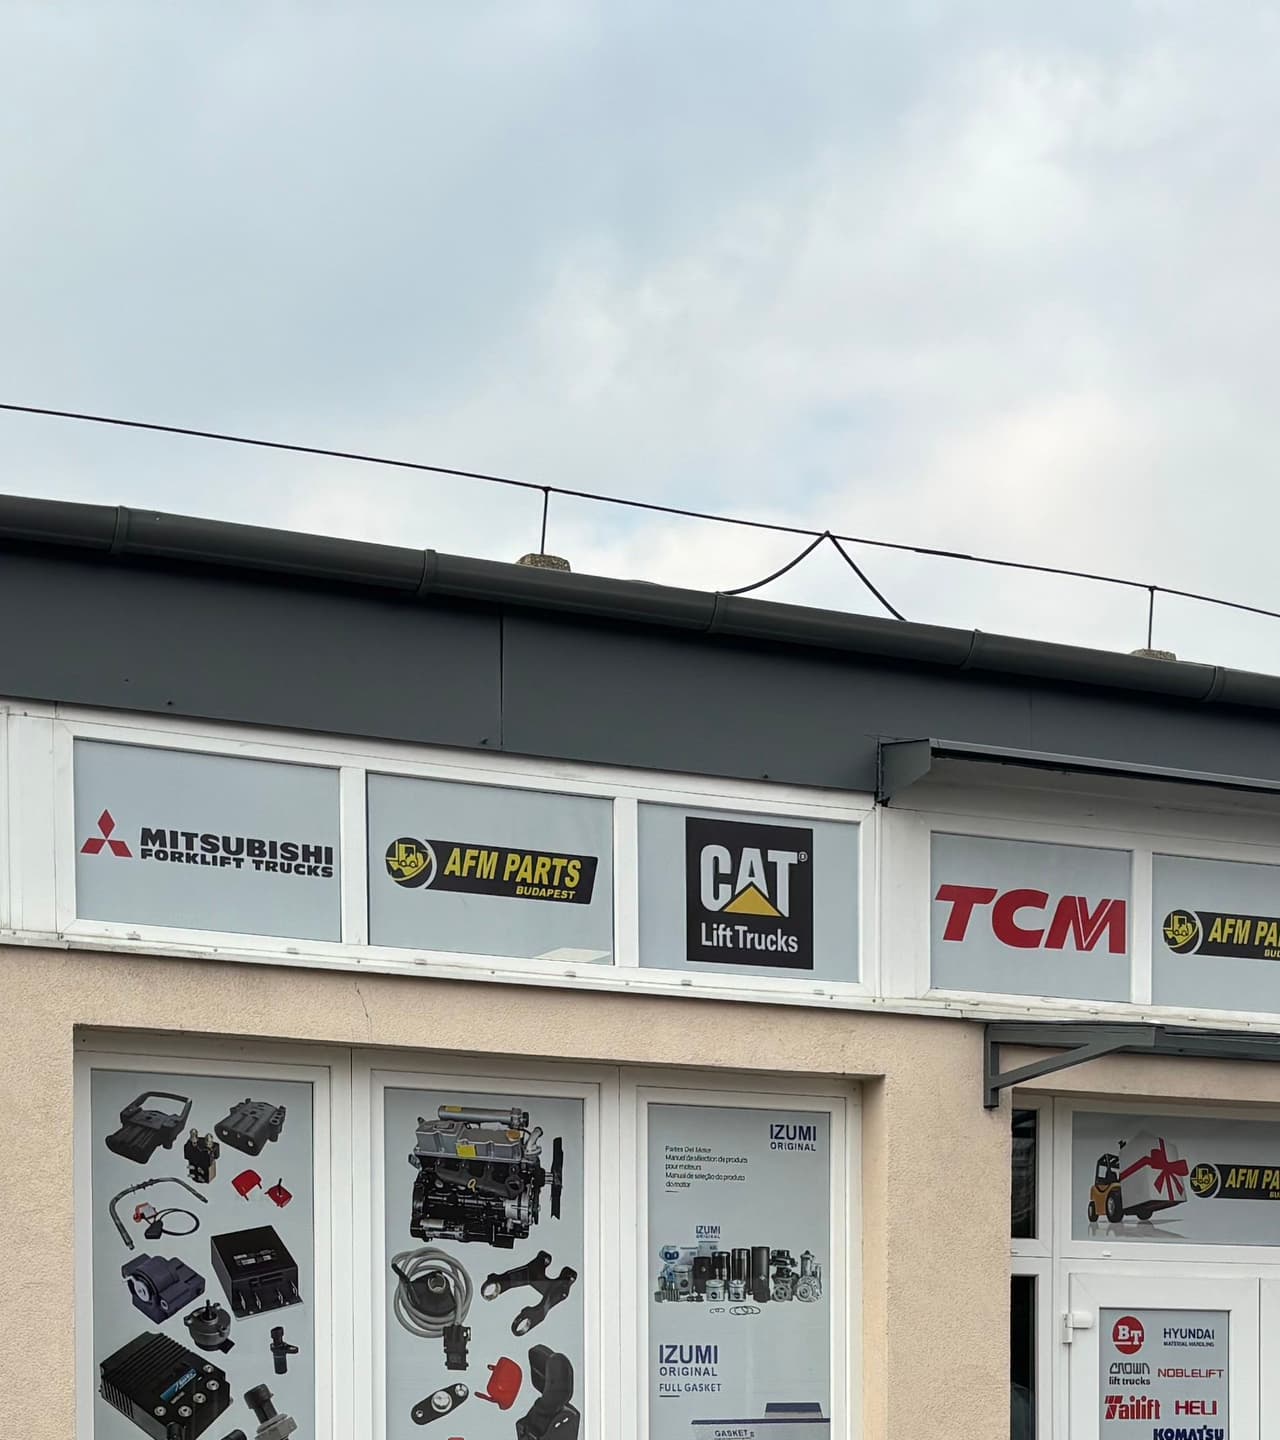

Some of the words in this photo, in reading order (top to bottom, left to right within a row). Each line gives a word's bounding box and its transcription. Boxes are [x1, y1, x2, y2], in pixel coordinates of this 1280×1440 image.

[140, 826, 335, 866] MITSUBISHI
[140, 846, 248, 871] FORKLIFT
[252, 859, 334, 878] TRUCKS
[443, 847, 499, 878] AFM
[503, 853, 581, 886] PARTS
[700, 843, 797, 917] CAT
[516, 885, 576, 901] BUDAPEST
[935, 884, 1126, 954] TCM
[701, 923, 734, 949] Lift
[735, 925, 799, 953] Trucks
[1208, 917, 1251, 944] AFM
[770, 1124, 817, 1141] IZUMI
[770, 1142, 816, 1151] ORIGINAL
[1225, 1169, 1259, 1190] AFM
[696, 1226, 720, 1234] IZUMI
[1118, 1325, 1142, 1345] BT
[1164, 1328, 1215, 1340] HYUNDAI
[659, 1344, 718, 1364] IZUMI
[659, 1367, 718, 1376] ORIGINAL
[1157, 1368, 1224, 1379] NOBLELIFT
[659, 1383, 682, 1392] FULL
[684, 1383, 722, 1392] GASKET
[1109, 1376, 1120, 1385] lift
[1122, 1377, 1151, 1385] trucks
[1105, 1395, 1161, 1420] Tailift
[1175, 1400, 1218, 1415] HELI
[714, 1429, 748, 1438] GASKET
[1153, 1425, 1224, 1440] KOMATSU
